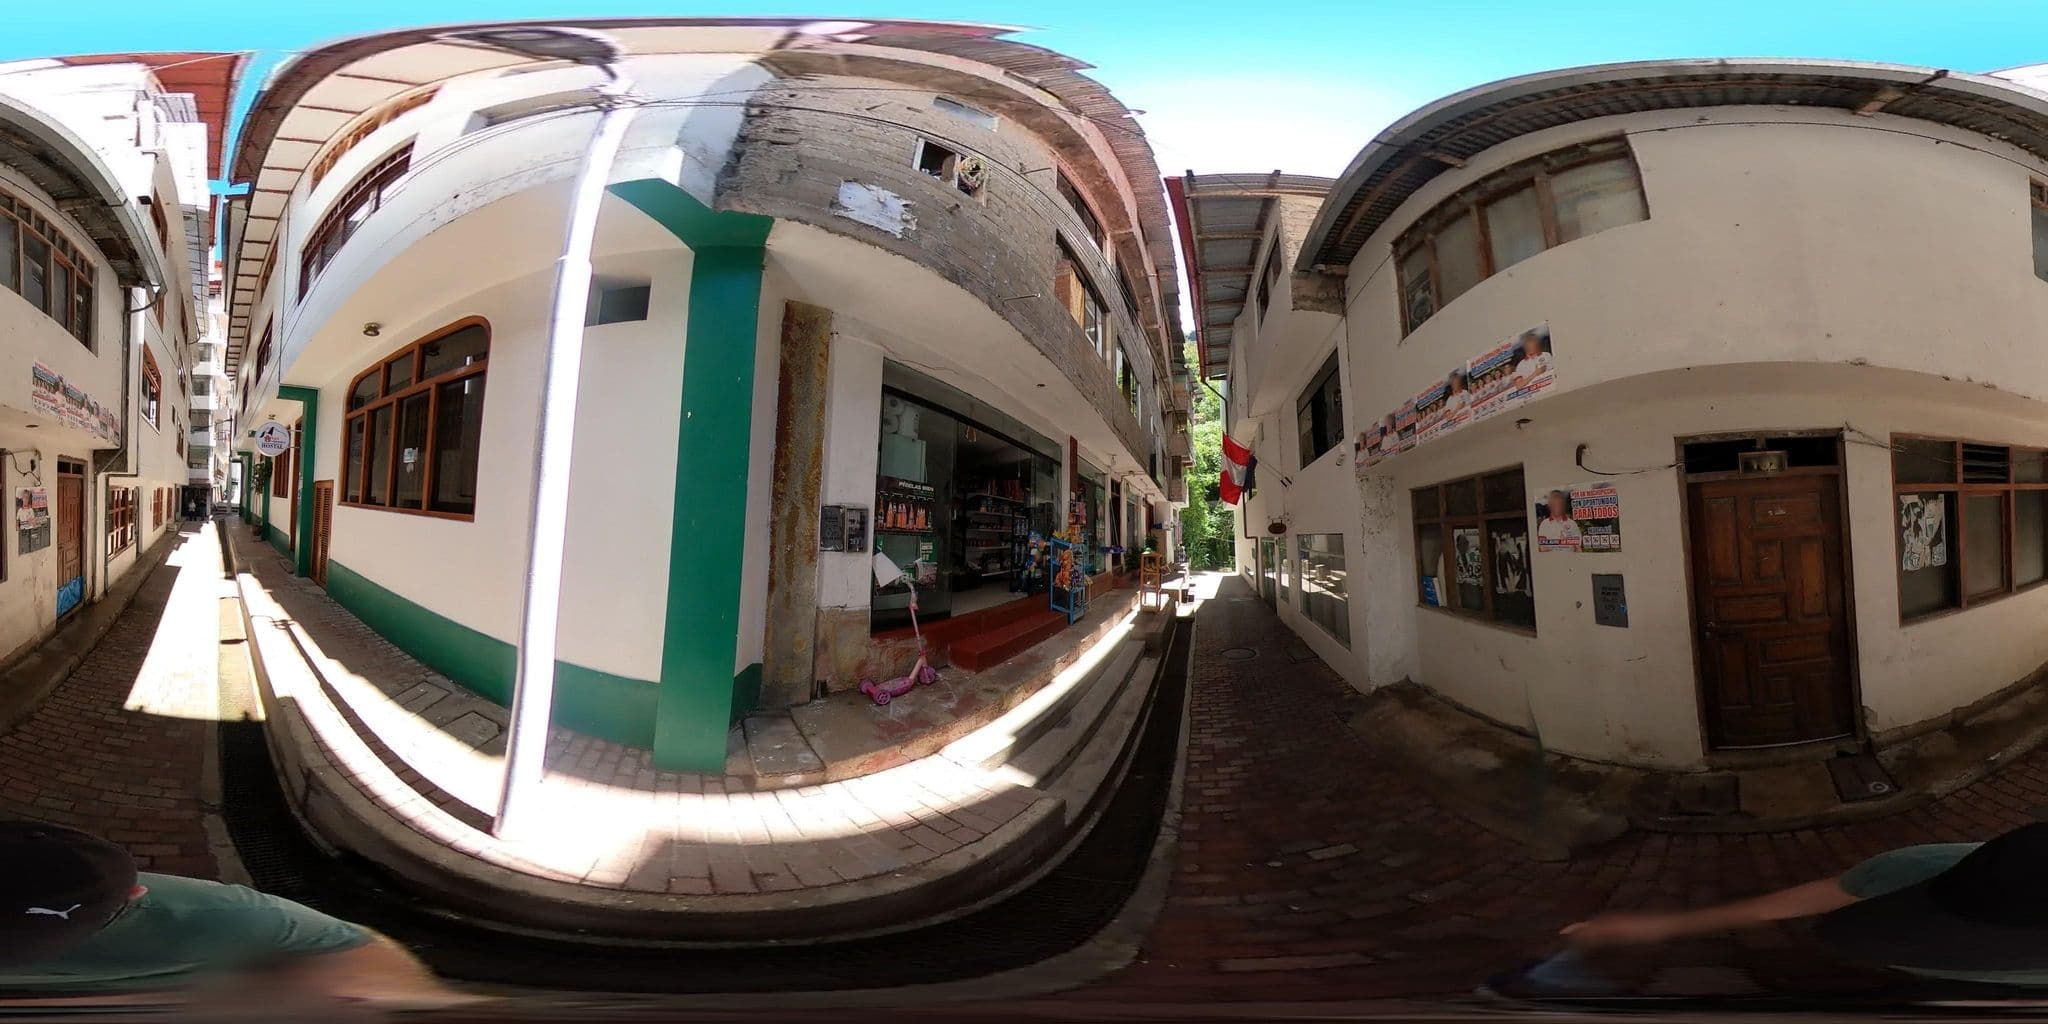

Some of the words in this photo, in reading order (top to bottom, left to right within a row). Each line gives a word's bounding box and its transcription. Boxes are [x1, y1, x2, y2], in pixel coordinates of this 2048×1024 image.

[1583, 496, 1617, 506] OPORTUNIDAD
[1573, 508, 1593, 519] PARA
[1593, 506, 1618, 518] TODOS
